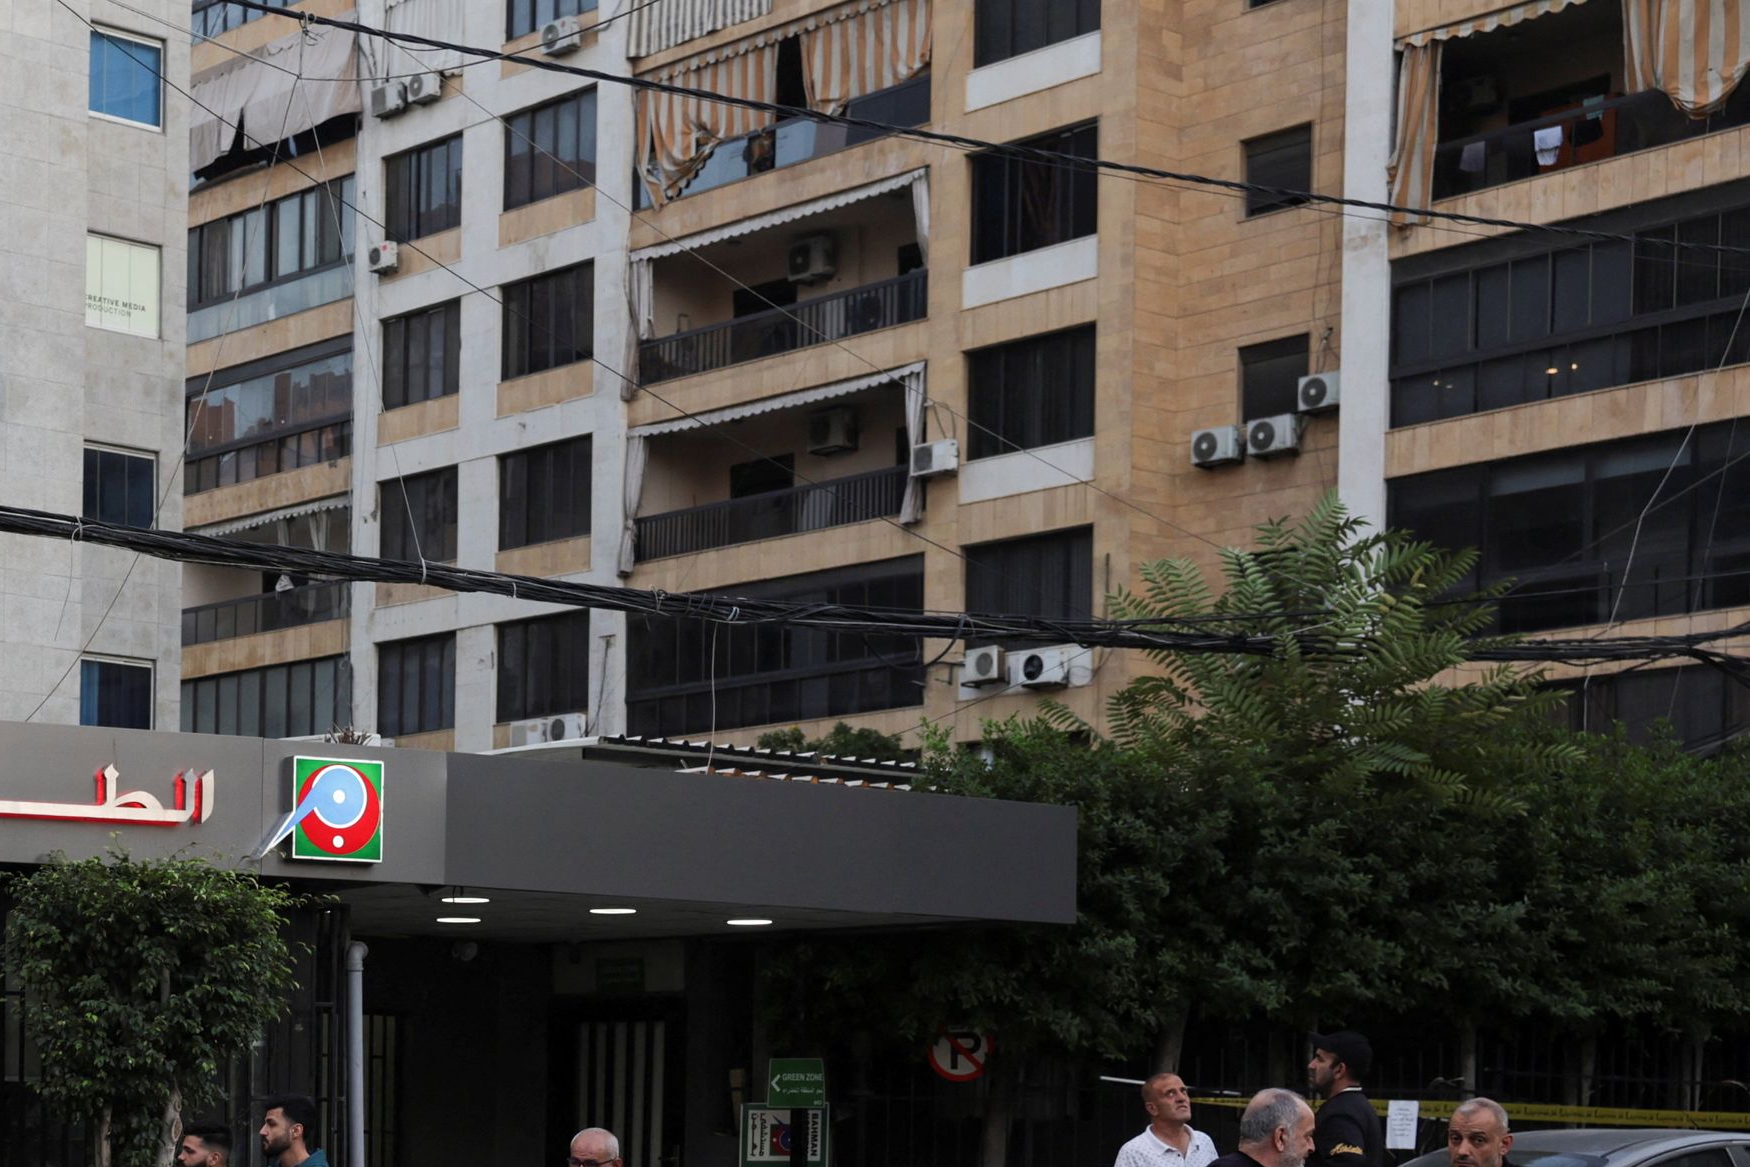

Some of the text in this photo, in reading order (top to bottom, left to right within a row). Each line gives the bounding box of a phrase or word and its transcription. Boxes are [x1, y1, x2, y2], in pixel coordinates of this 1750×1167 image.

[122, 301, 146, 312] MEDIA
[782, 1073, 825, 1081] GREEN ZONE
[811, 1113, 819, 1157] BAHMAN
